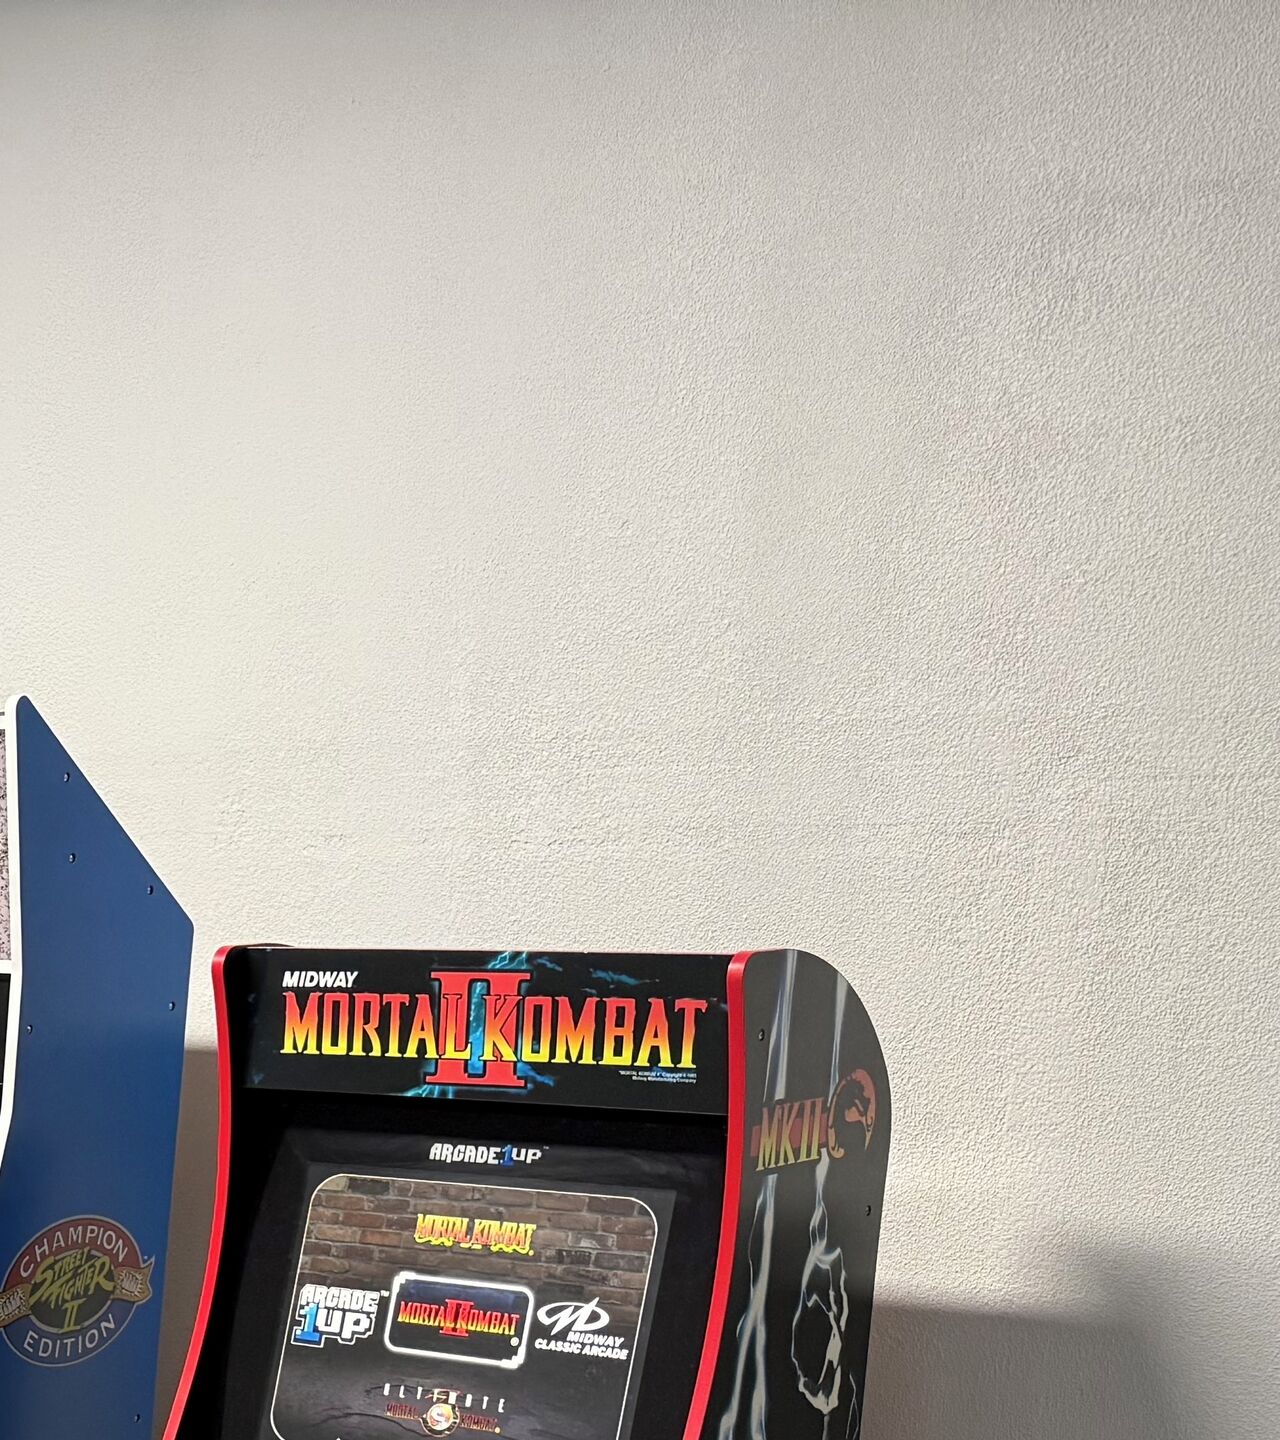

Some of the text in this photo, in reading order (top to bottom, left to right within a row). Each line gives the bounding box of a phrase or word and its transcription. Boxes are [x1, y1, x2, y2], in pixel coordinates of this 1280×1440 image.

[282, 970, 359, 988] MIDWAY
[280, 991, 708, 1069] MORTAL KOMBAT
[20, 1225, 128, 1278] CHAMPION
[415, 1213, 537, 1253] MORTAL KOMBAT
[29, 1246, 90, 1306] STREET
[44, 1256, 116, 1309] FIGHTER
[58, 1298, 87, 1334] II
[299, 1283, 380, 1313] ARCADE
[397, 1300, 520, 1336] MORTAL KOMBAT
[24, 1313, 116, 1358] EDITION
[292, 1302, 377, 1347] 1UP
[567, 1331, 625, 1347] MIDWAY
[534, 1339, 628, 1360] CLASSIC ARCADE
